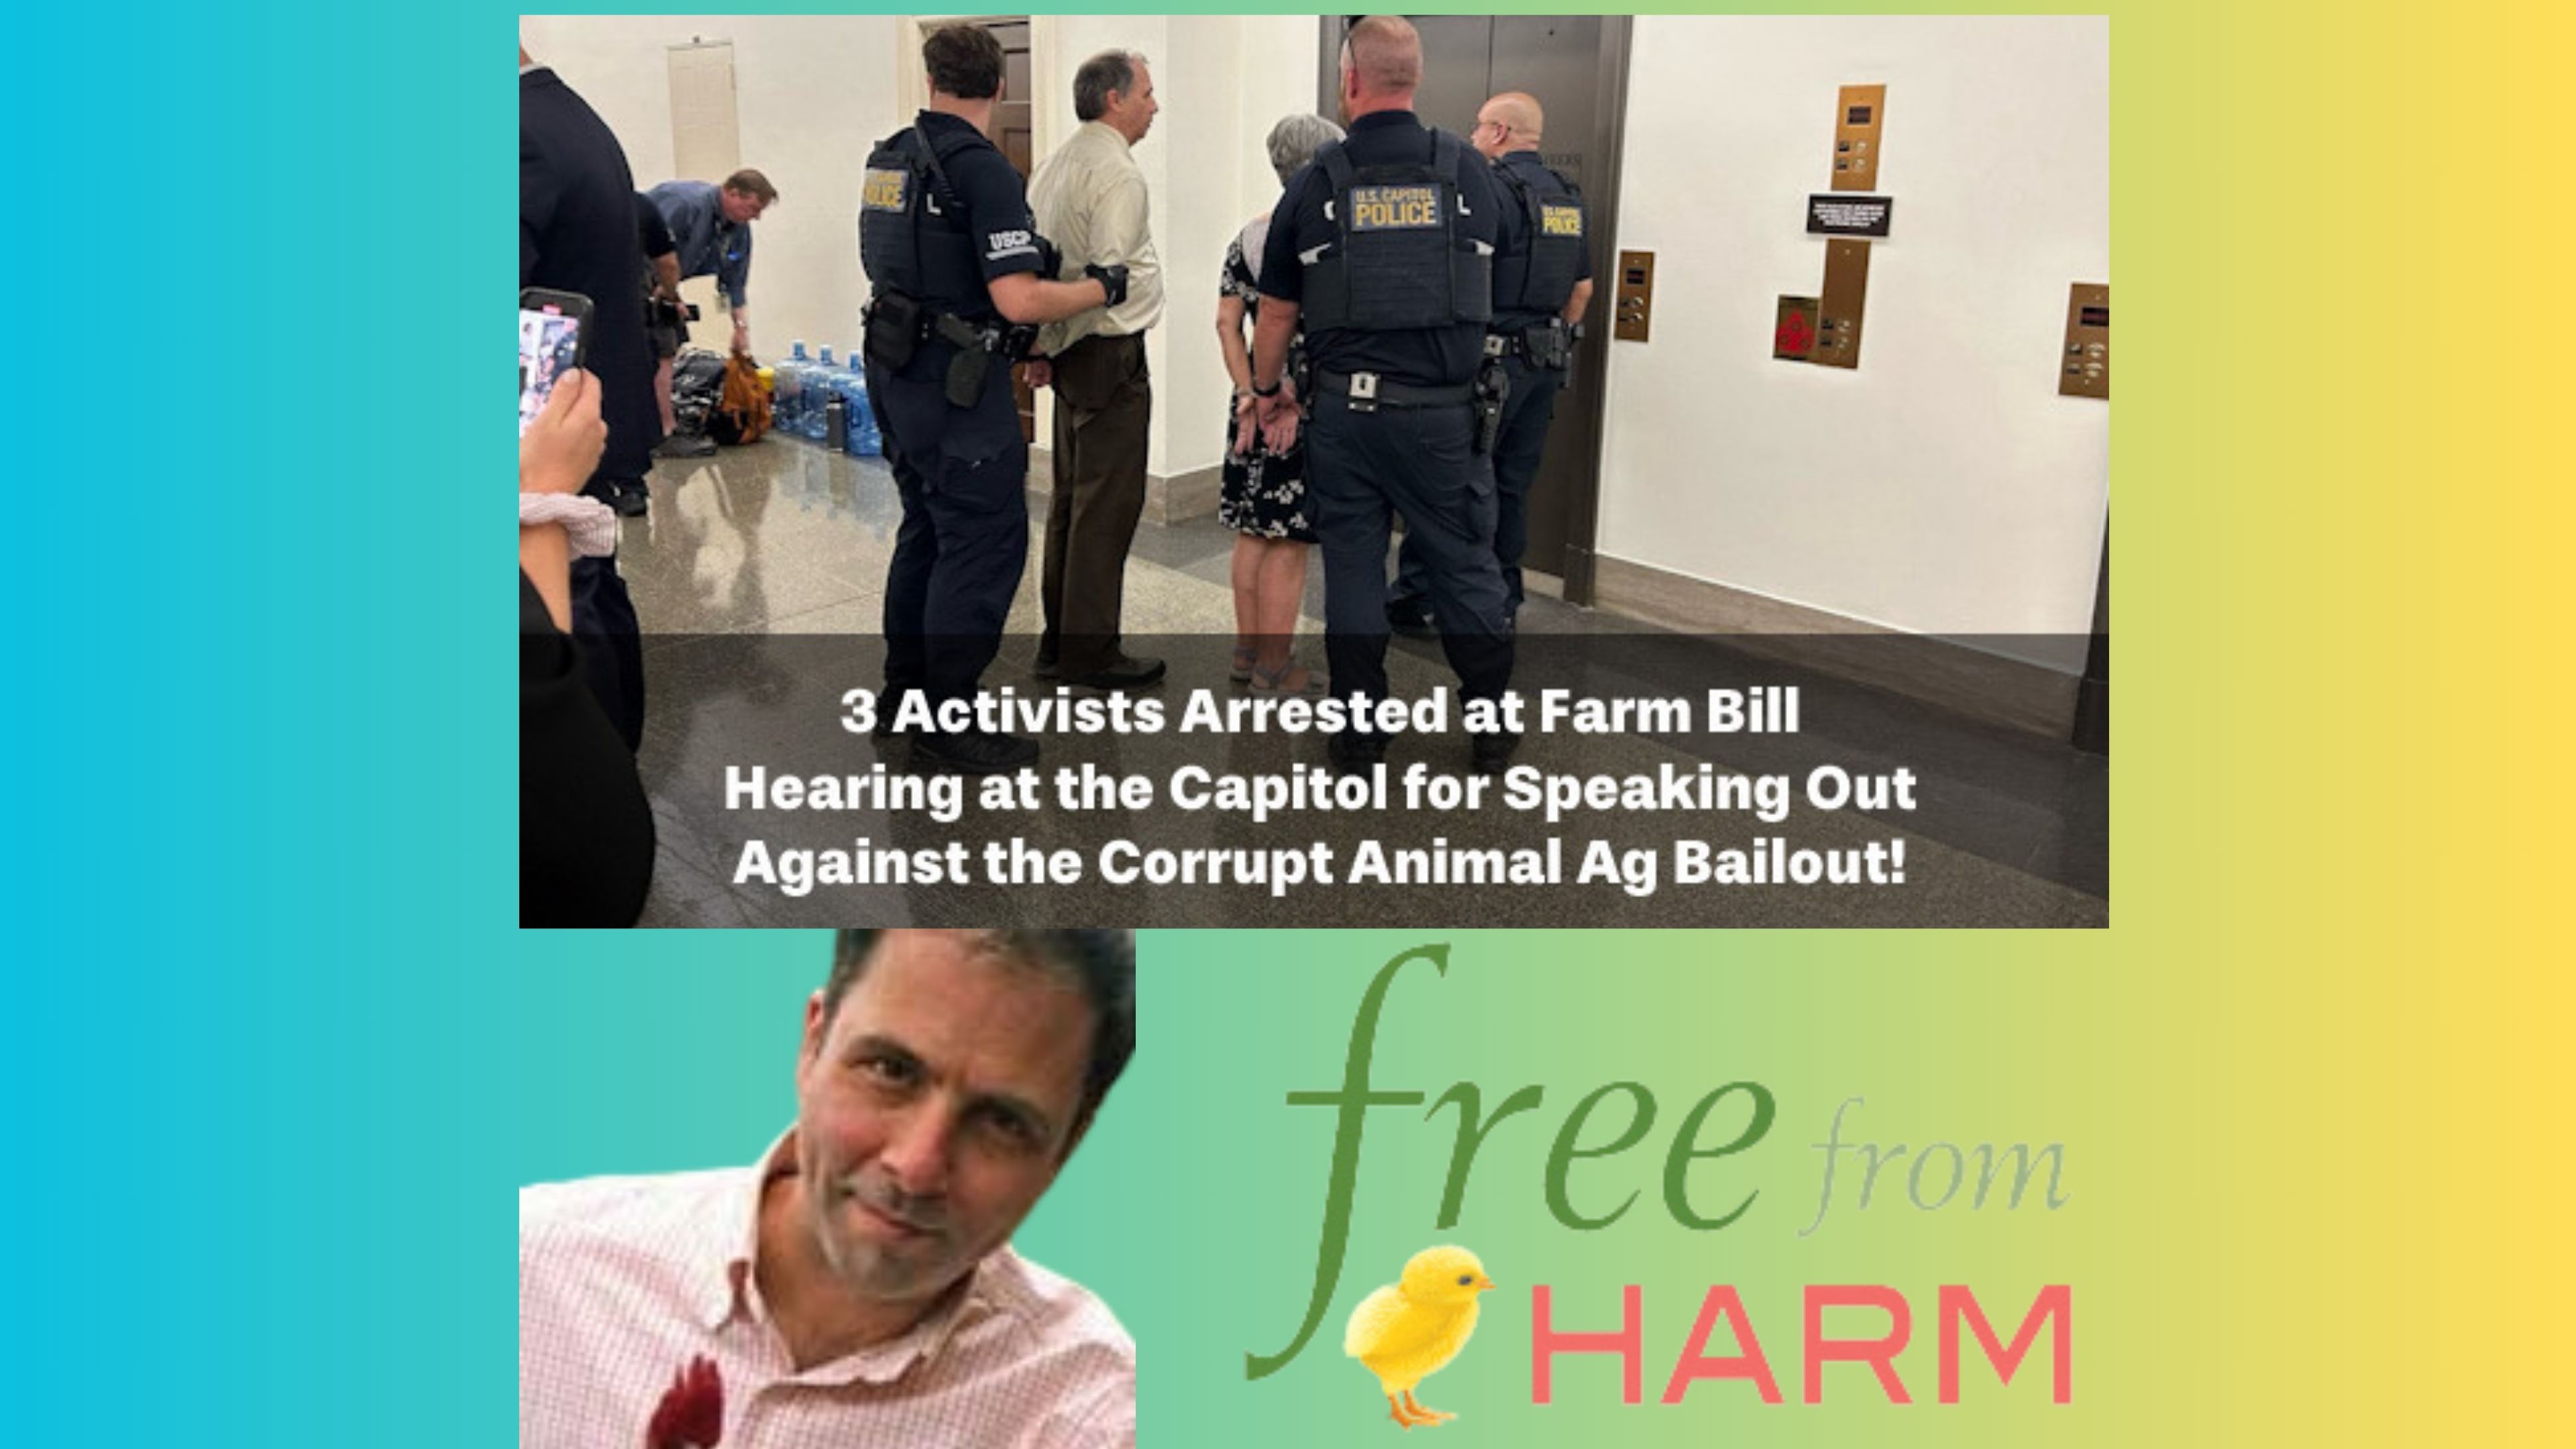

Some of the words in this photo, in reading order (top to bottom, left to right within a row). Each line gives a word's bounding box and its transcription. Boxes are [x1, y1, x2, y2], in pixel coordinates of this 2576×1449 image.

[1355, 190, 1377, 203] U.S.
[1381, 187, 1435, 202] CAPITOL
[1355, 201, 1437, 226] POLICE
[988, 230, 1032, 250] USCP
